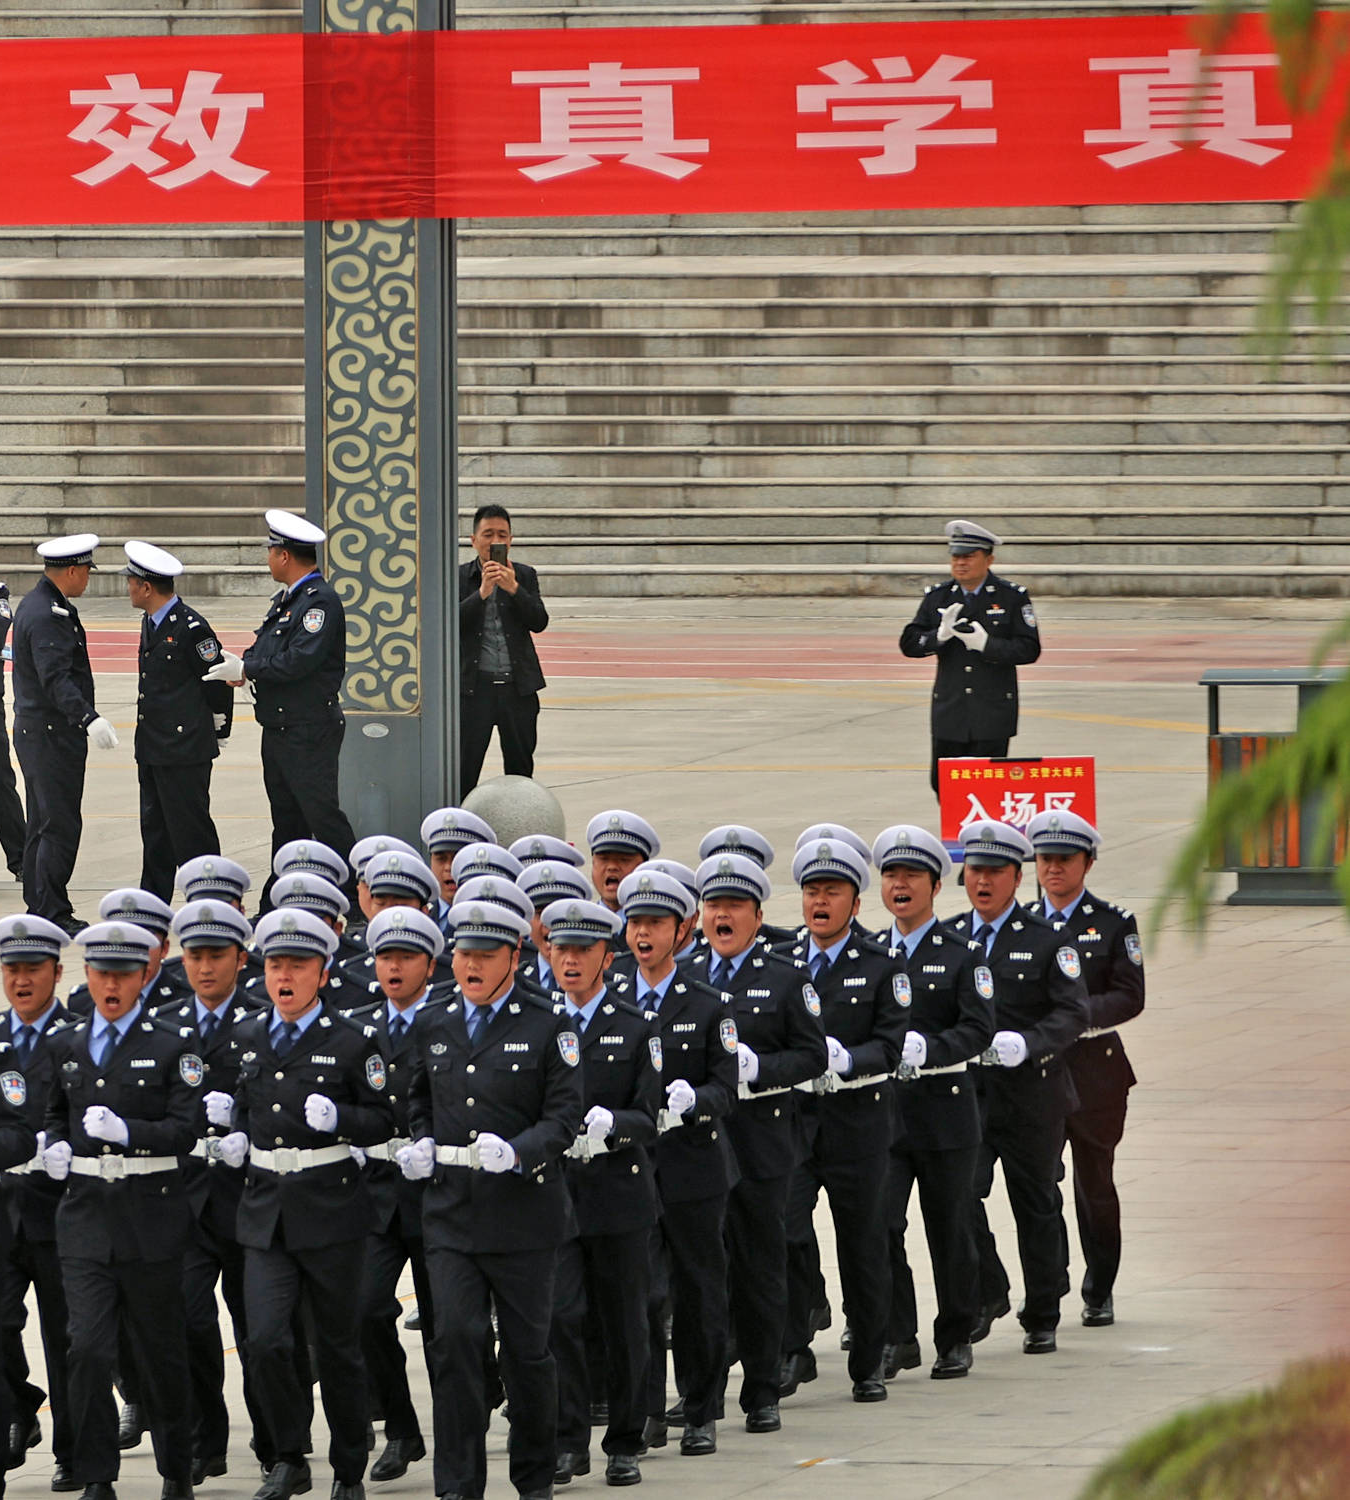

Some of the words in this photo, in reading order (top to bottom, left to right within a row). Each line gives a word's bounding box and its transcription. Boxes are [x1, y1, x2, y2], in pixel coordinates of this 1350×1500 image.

[505, 49, 1293, 182] 真学真
[950, 768, 1005, 780] 备战十四运
[1029, 766, 1085, 779] 交警大练兵
